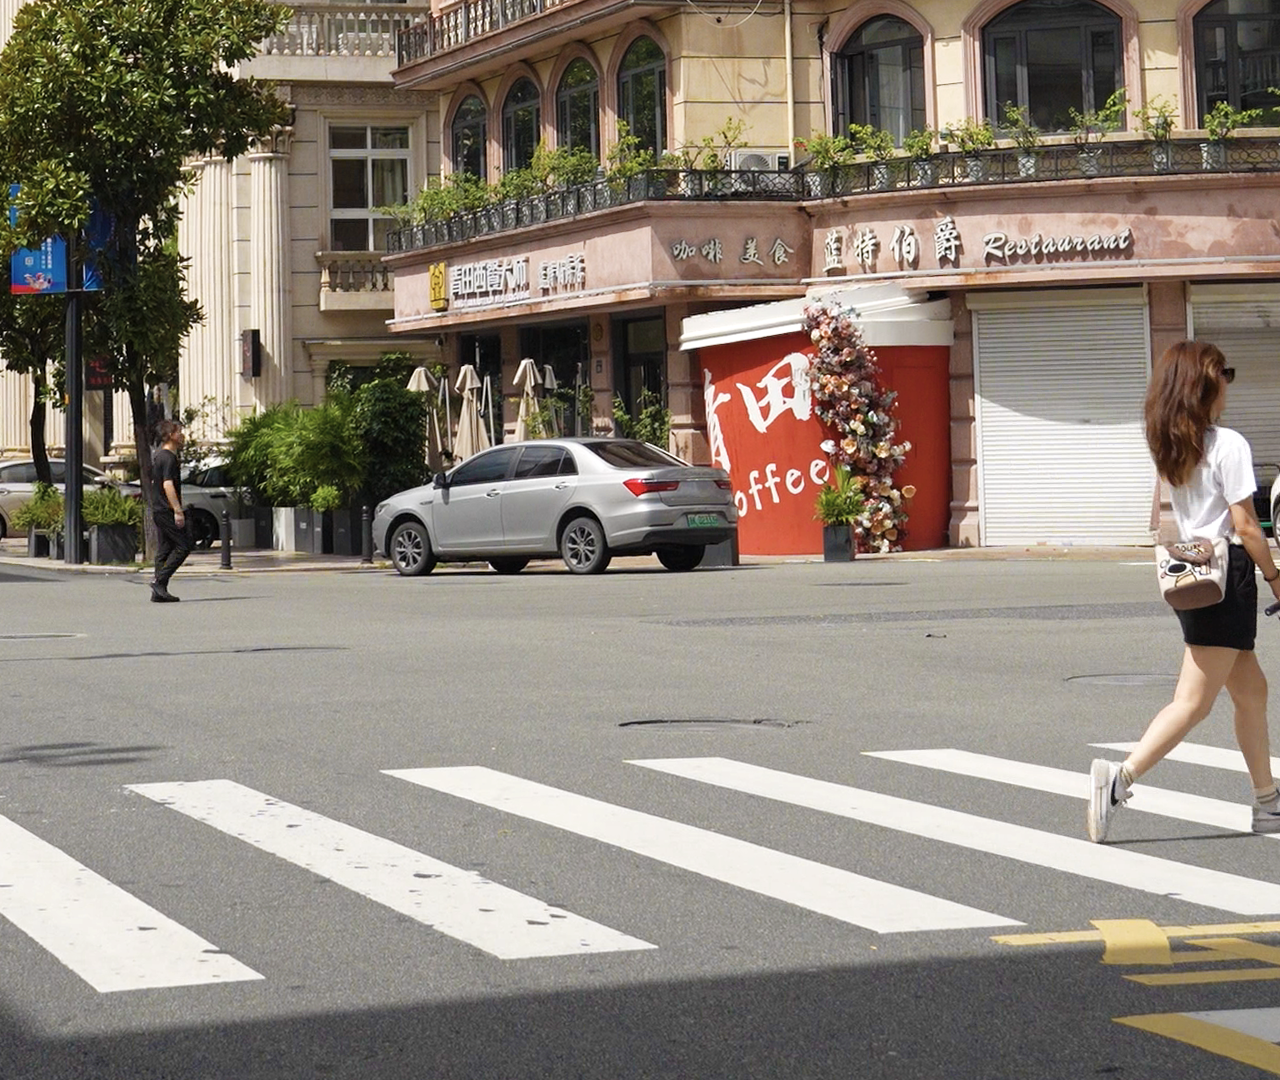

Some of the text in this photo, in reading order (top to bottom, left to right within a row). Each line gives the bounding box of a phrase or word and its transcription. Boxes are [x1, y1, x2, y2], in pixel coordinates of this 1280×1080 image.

[672, 237, 794, 266] 咖啡 美食
[982, 227, 1131, 260] Restaurant
[733, 458, 830, 518] offee
